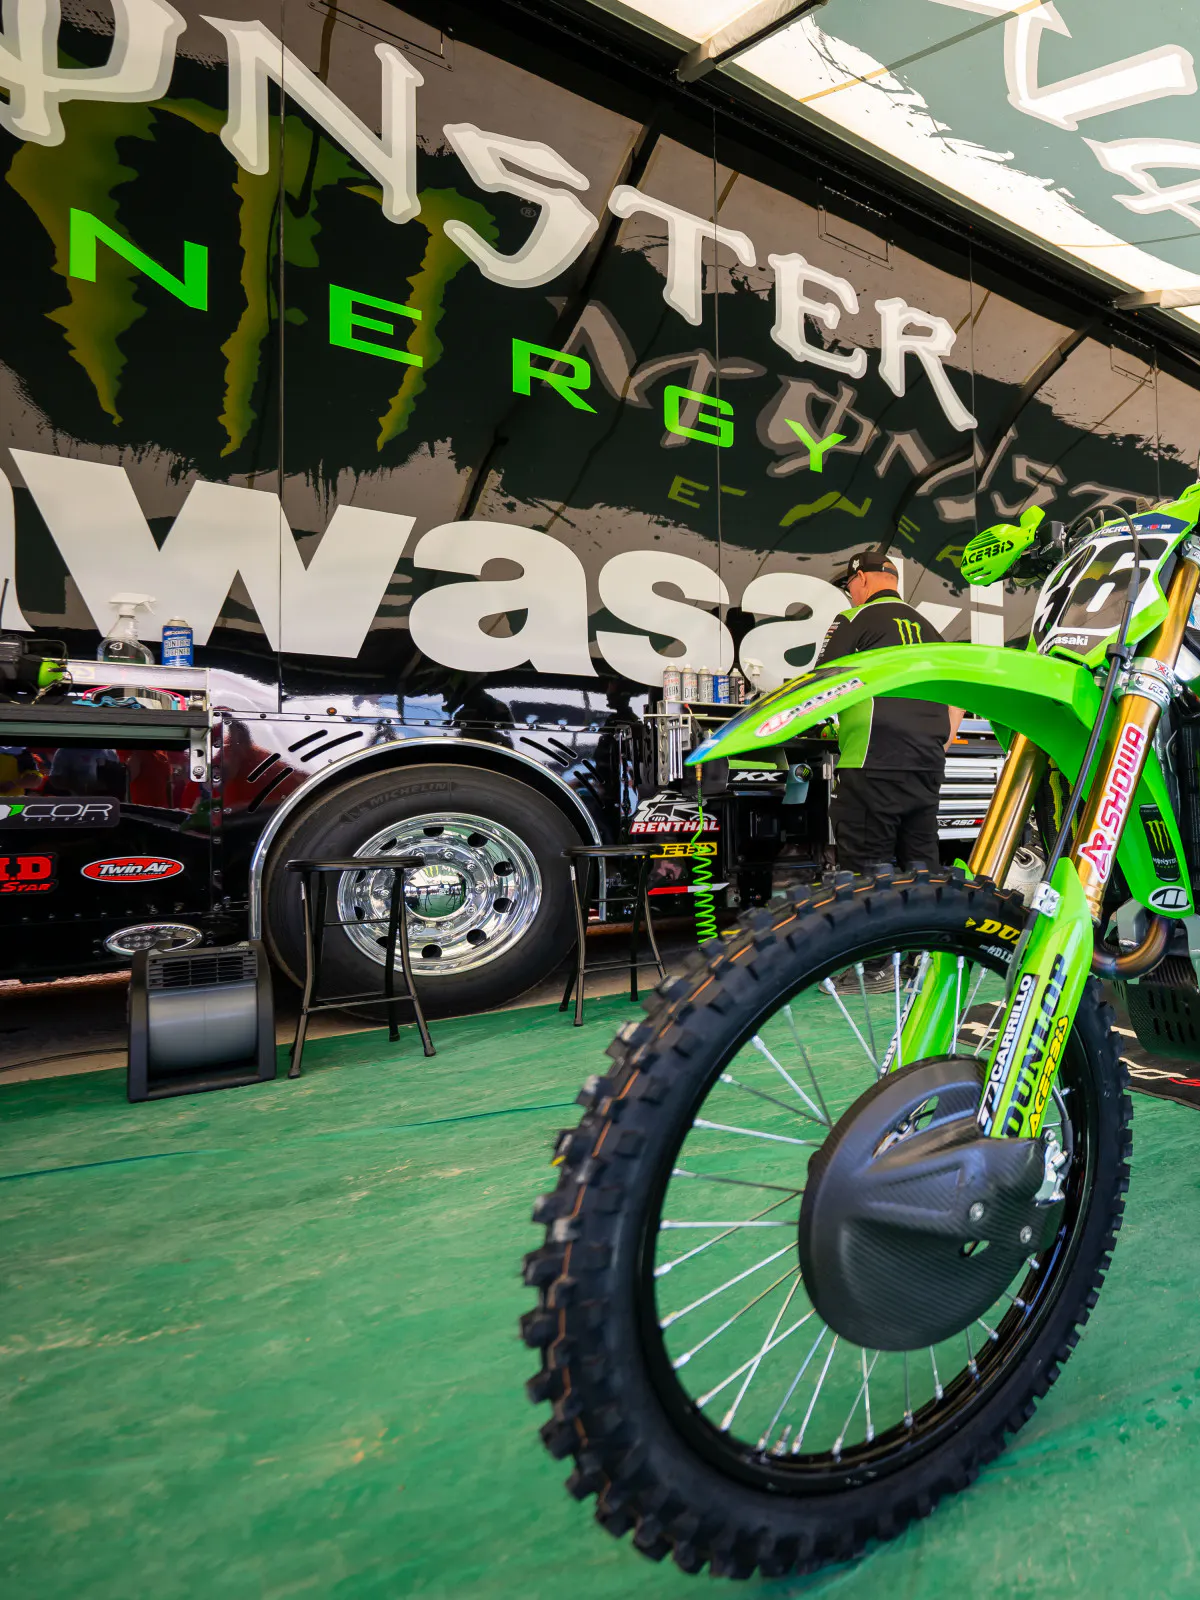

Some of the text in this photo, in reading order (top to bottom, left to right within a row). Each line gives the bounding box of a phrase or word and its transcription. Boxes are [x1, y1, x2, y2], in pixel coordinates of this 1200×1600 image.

[732, 771, 784, 782] KX
[1101, 724, 1144, 835] SHOWA
[630, 821, 720, 834] RENTHAL
[100, 861, 173, 875] Twin Air
[990, 974, 1033, 1082] CARRILLO
